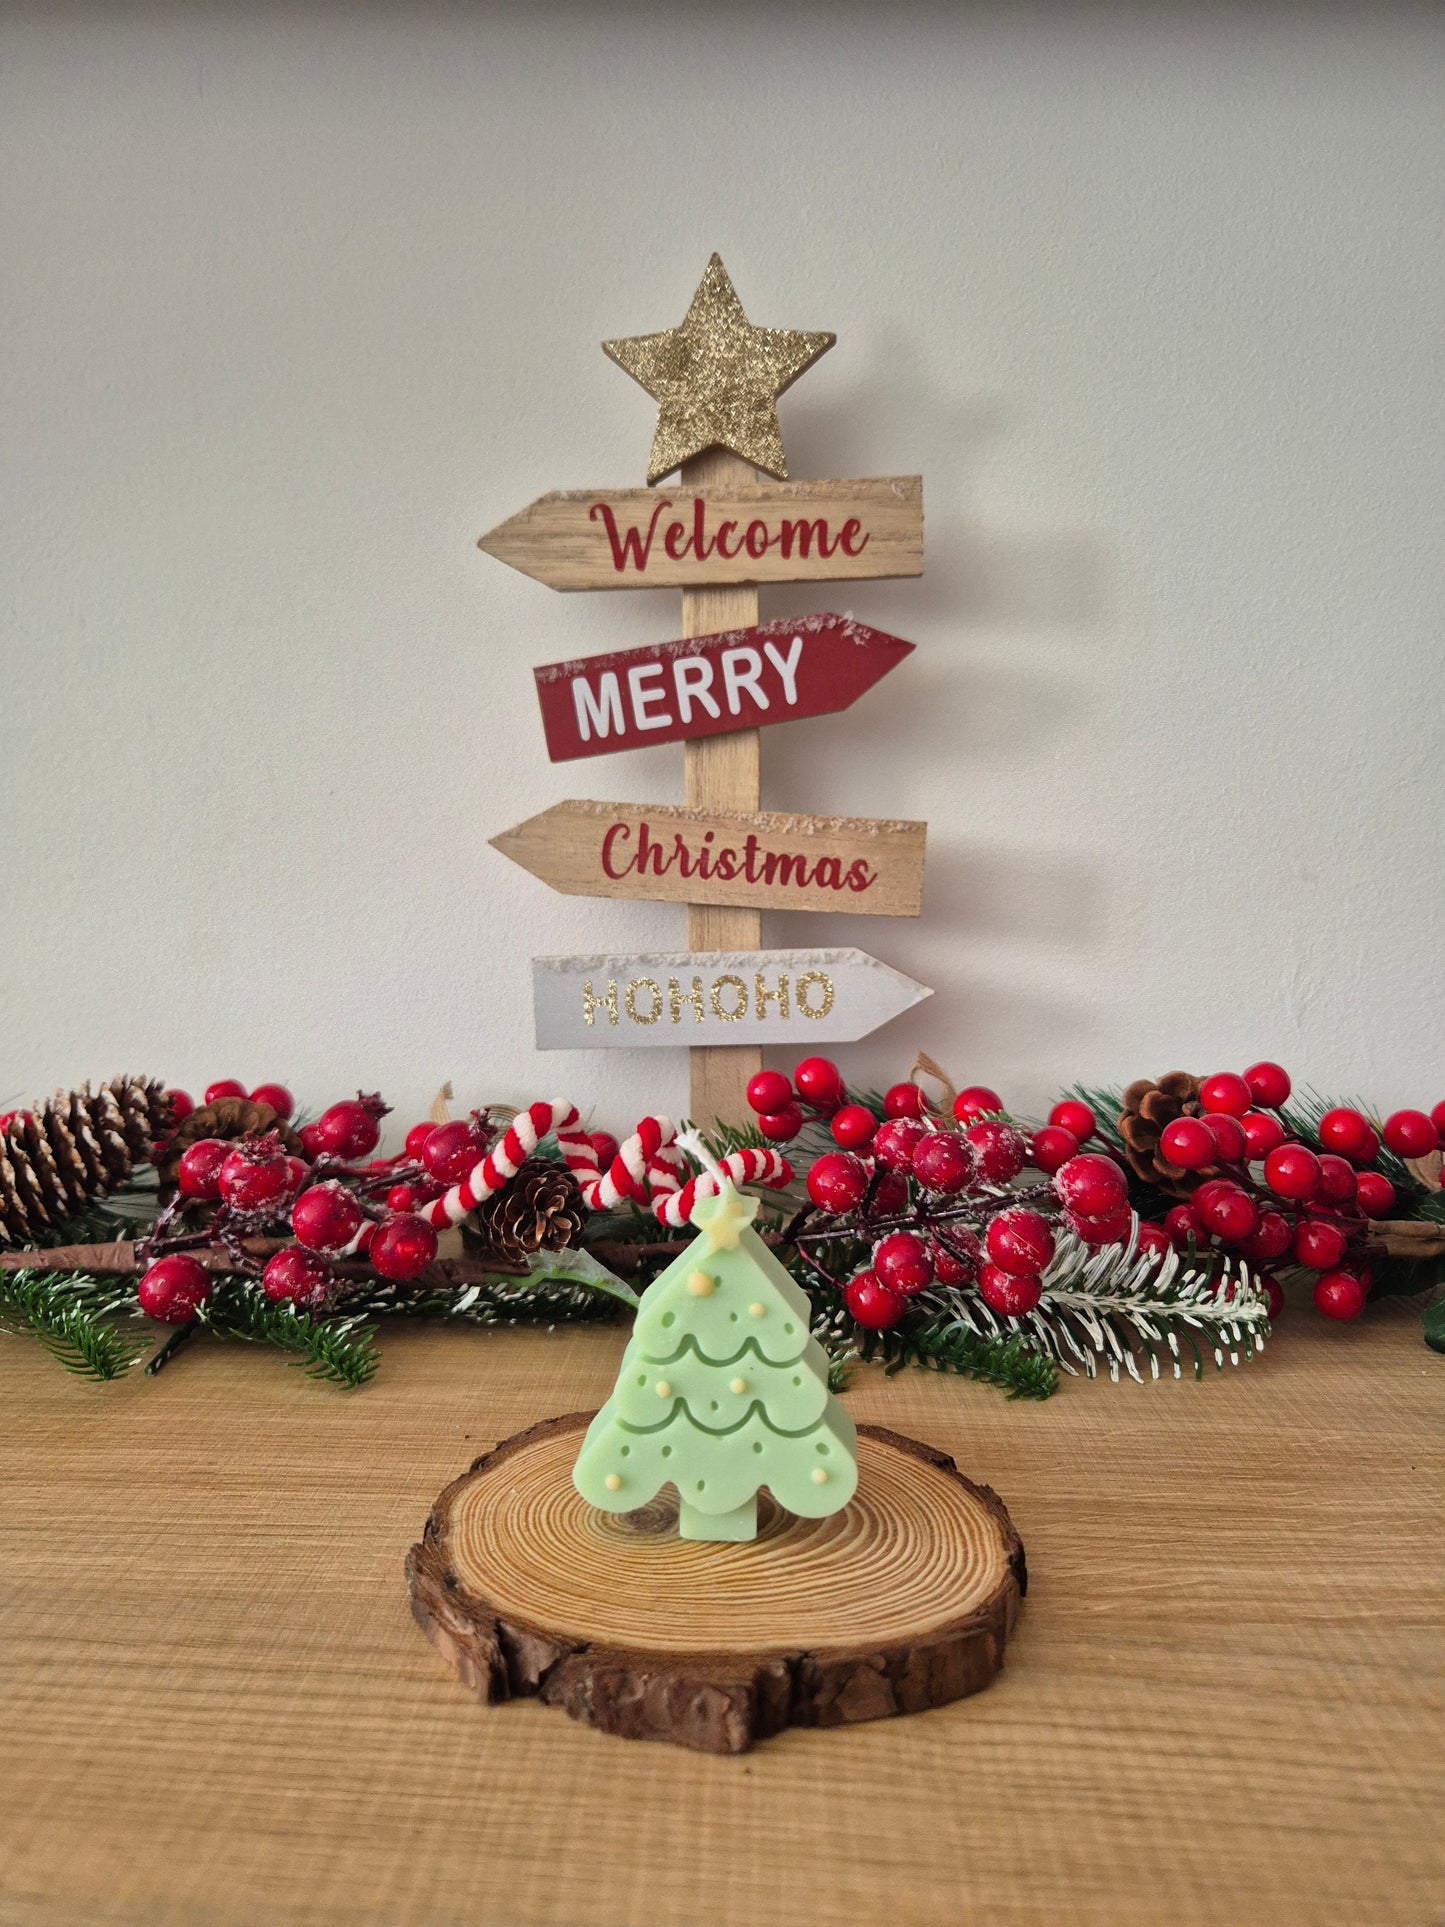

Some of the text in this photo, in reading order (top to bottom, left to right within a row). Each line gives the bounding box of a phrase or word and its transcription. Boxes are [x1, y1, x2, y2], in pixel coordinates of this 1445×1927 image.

[589, 498, 870, 572] Welcome
[572, 636, 803, 742] MERRY
[601, 823, 878, 893] Christmas
[582, 971, 835, 1027] HOHOHO
